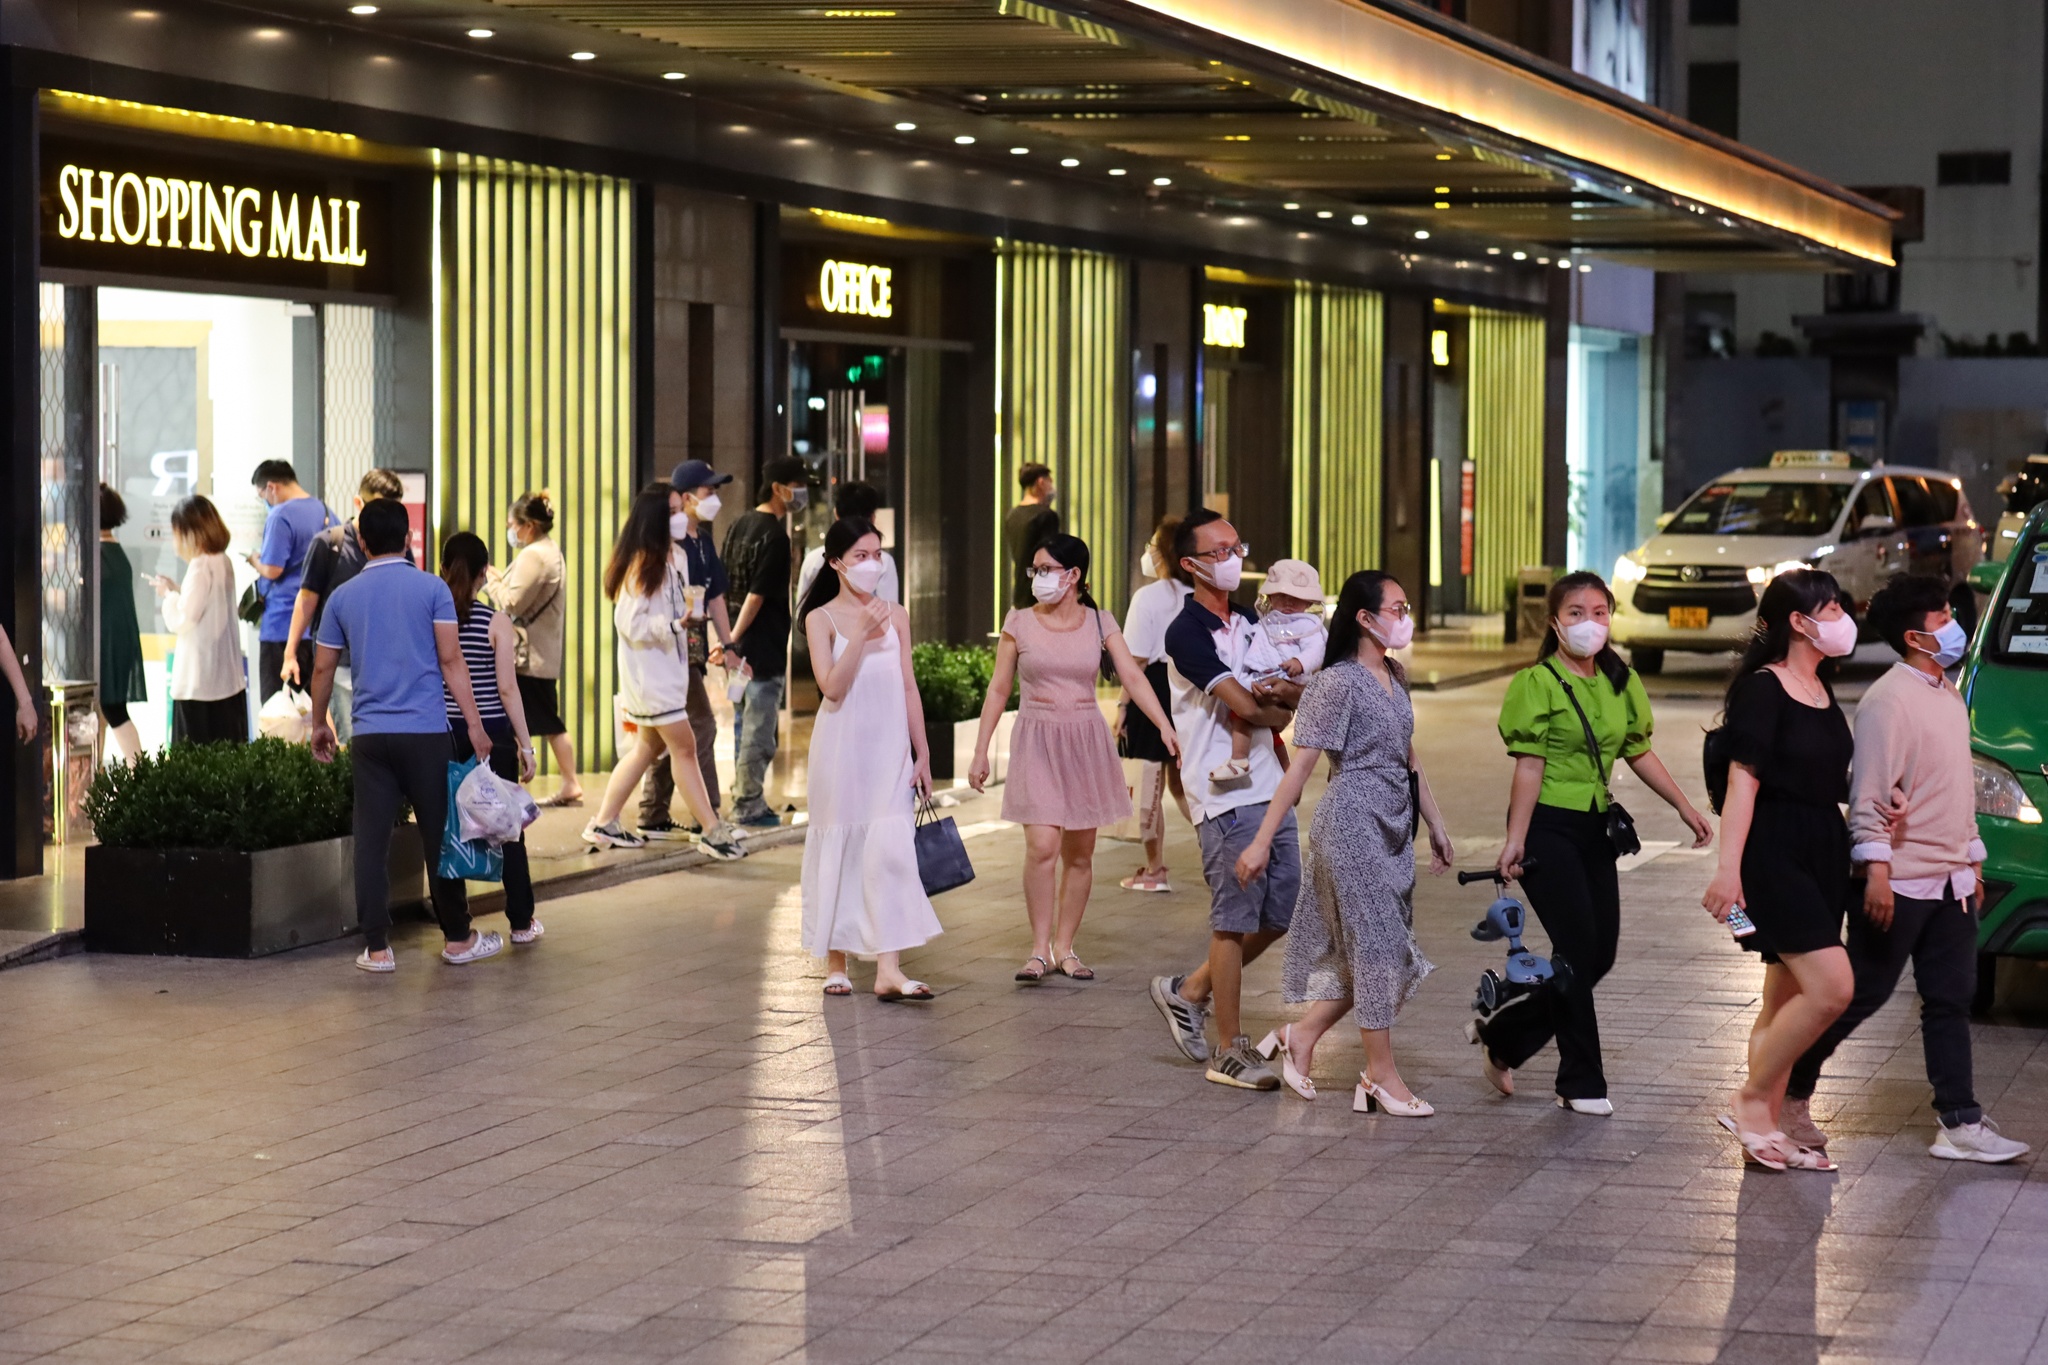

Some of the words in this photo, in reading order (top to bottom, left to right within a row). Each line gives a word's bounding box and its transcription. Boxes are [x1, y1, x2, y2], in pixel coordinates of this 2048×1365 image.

[58, 164, 263, 258] SHOPPING
[267, 190, 367, 267] MALL
[819, 258, 892, 318] OFFICE
